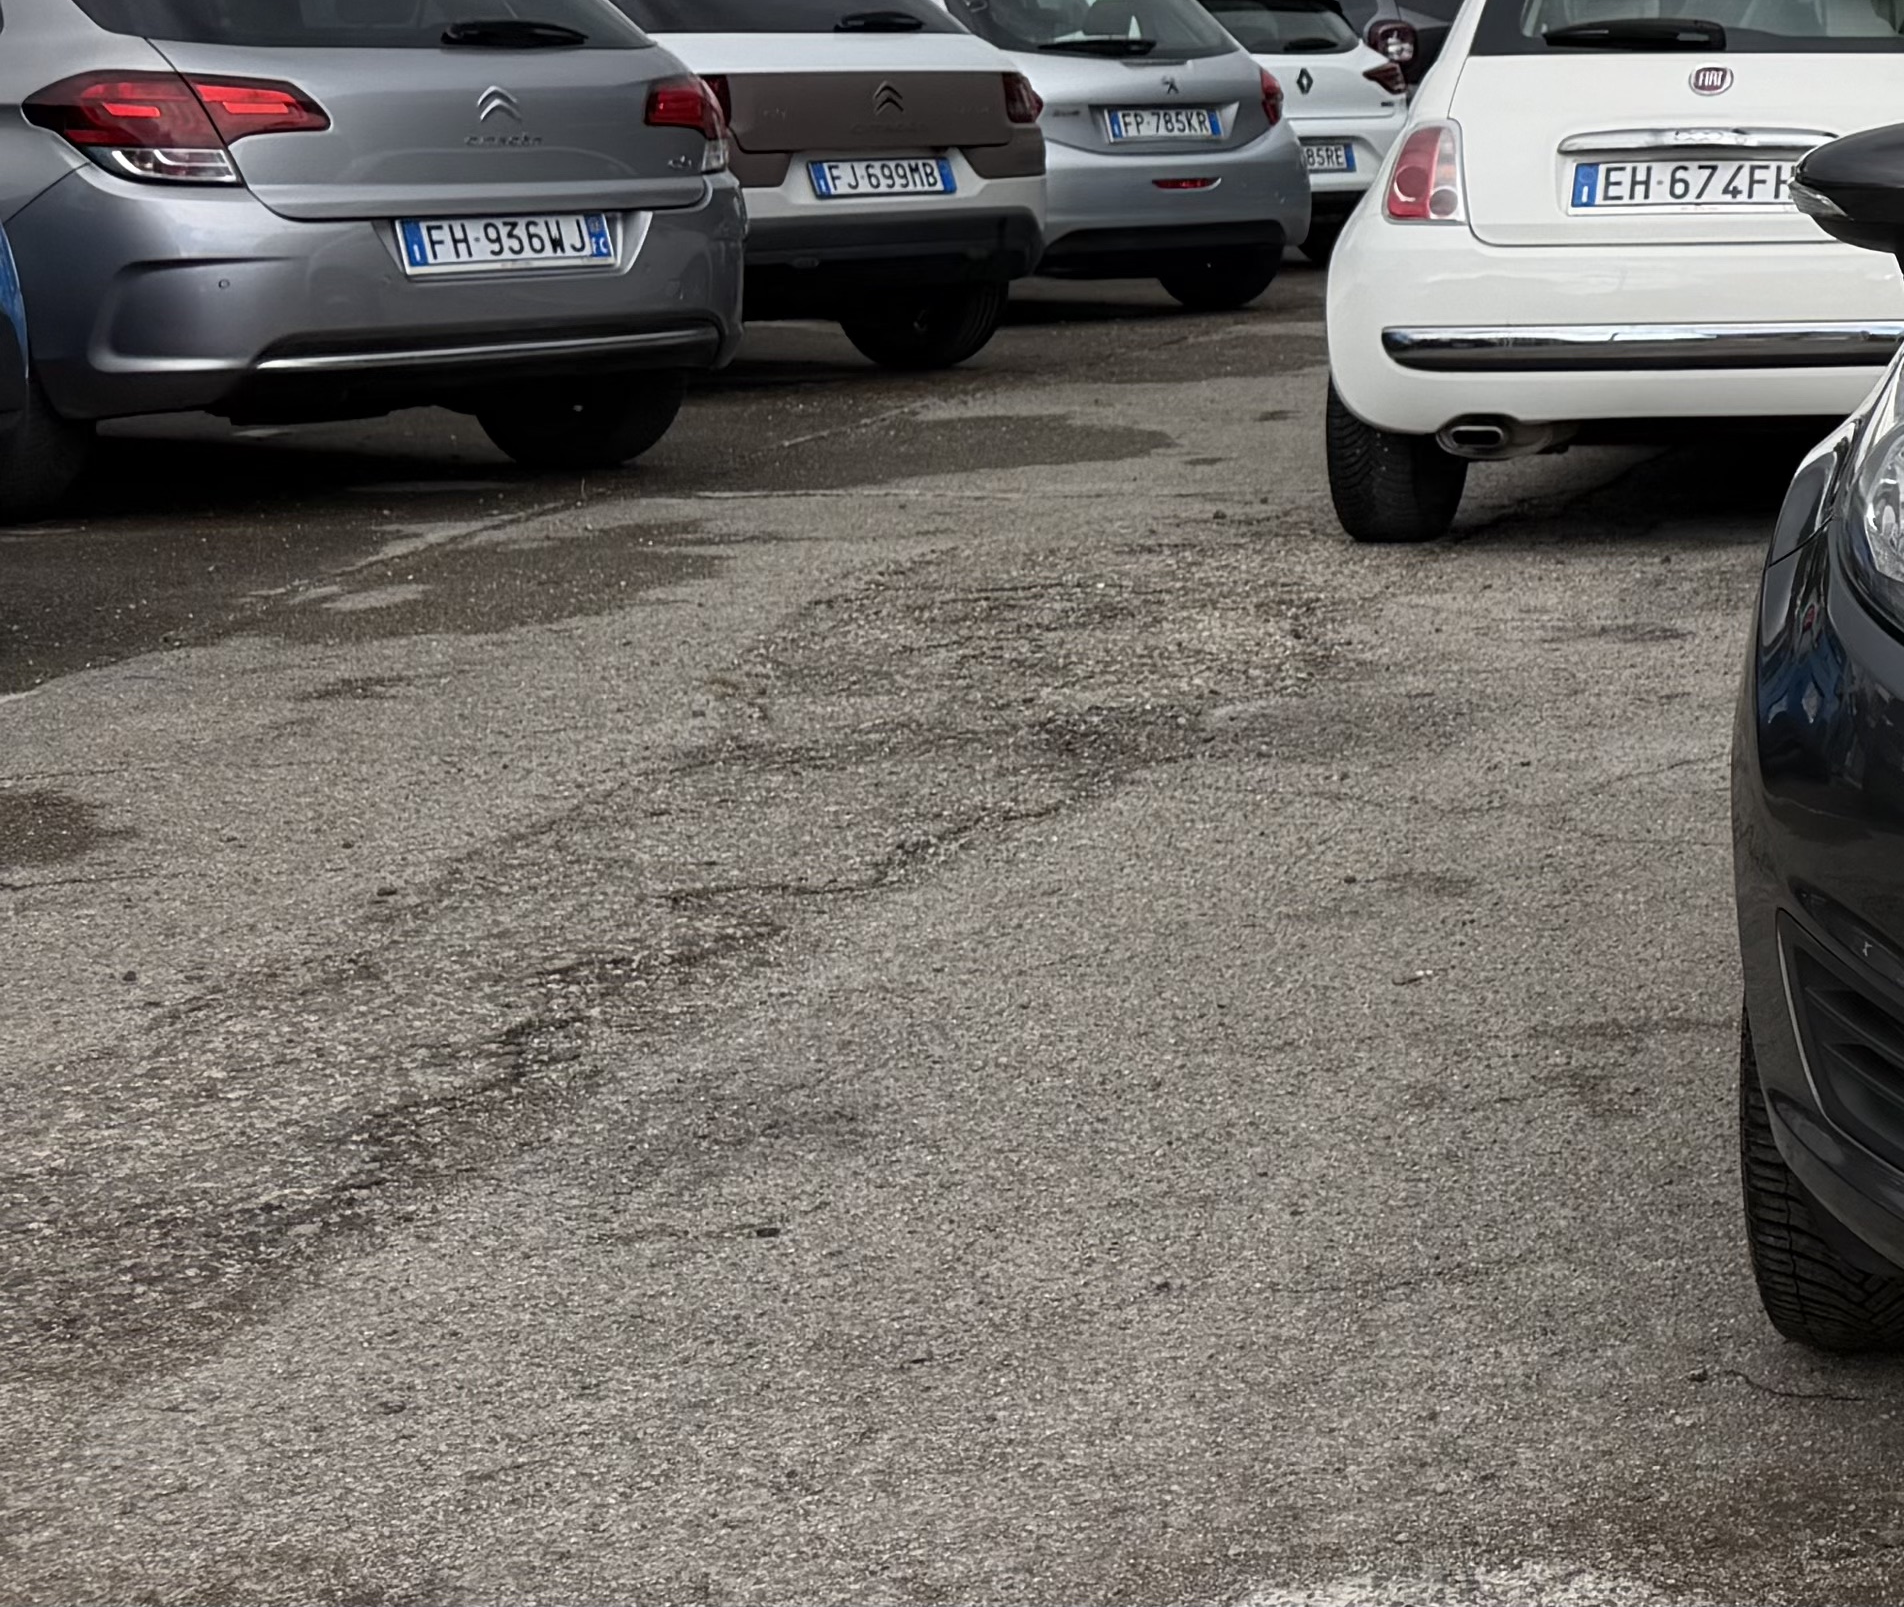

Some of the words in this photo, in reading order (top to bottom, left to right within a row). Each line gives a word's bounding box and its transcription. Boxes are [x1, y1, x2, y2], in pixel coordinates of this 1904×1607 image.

[1698, 70, 1724, 86] FIAT
[1121, 112, 1144, 135] FP
[1151, 111, 1210, 134] 785KR
[1302, 144, 1345, 167] 85RE
[827, 162, 860, 192] FJ
[864, 161, 938, 190] 699MB
[1602, 165, 1653, 202] EH
[425, 222, 473, 261] FH
[483, 217, 587, 256] 936WJ
